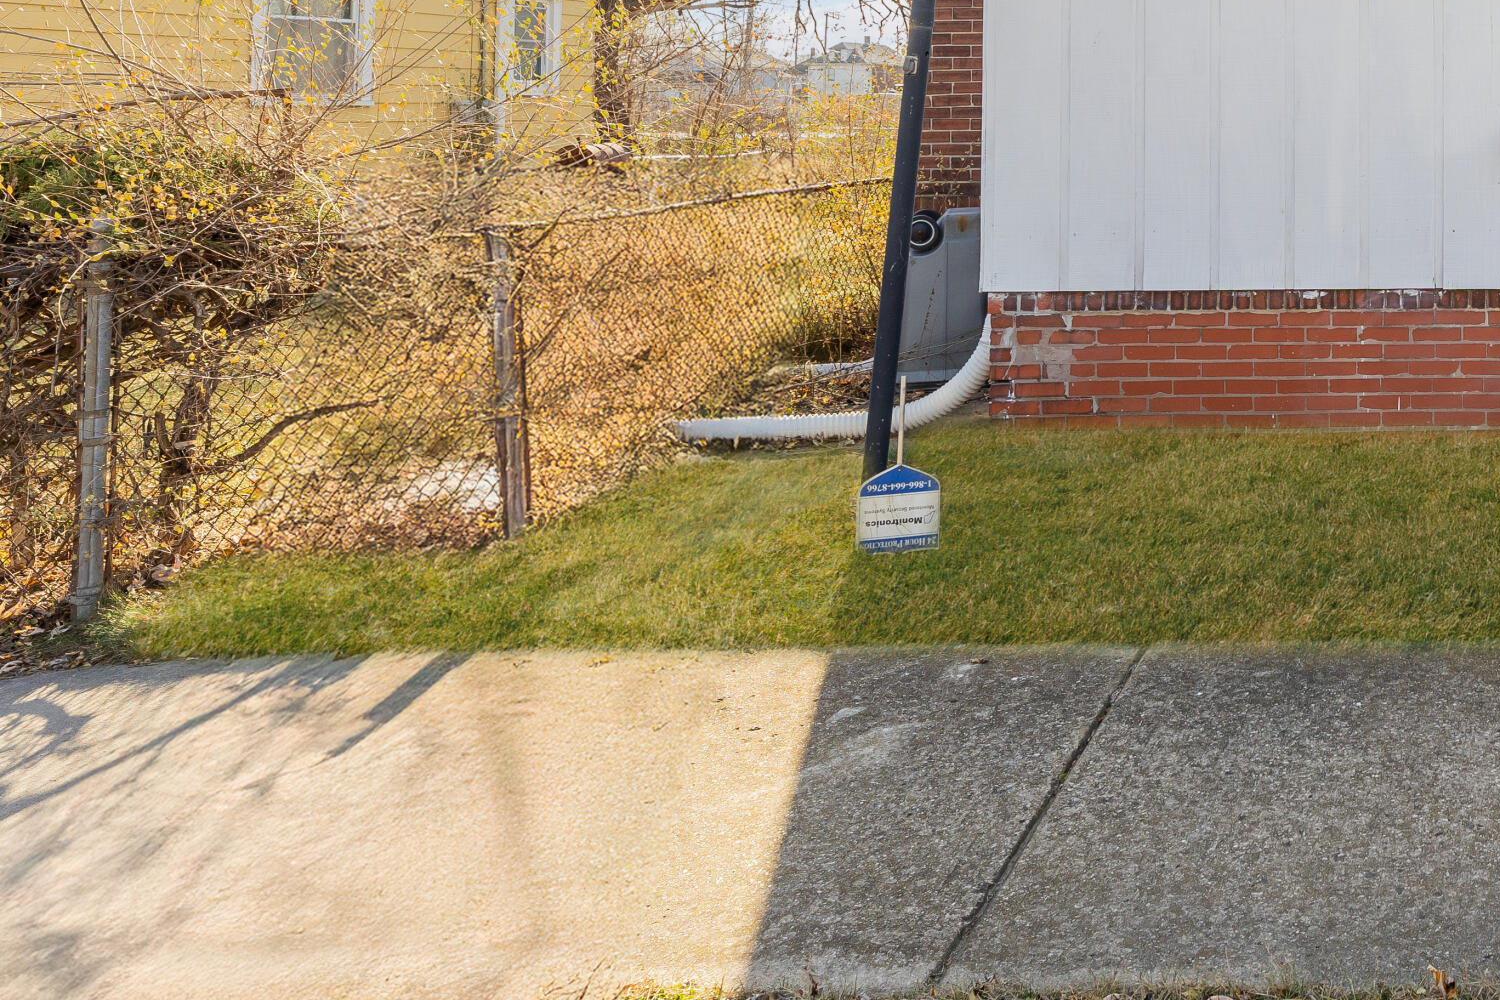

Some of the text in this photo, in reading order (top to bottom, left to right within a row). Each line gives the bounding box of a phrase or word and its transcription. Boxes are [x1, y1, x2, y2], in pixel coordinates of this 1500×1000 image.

[867, 480, 932, 492] 1-866-664-8766
[865, 517, 923, 528] Monitronics
[927, 536, 937, 544] 24
